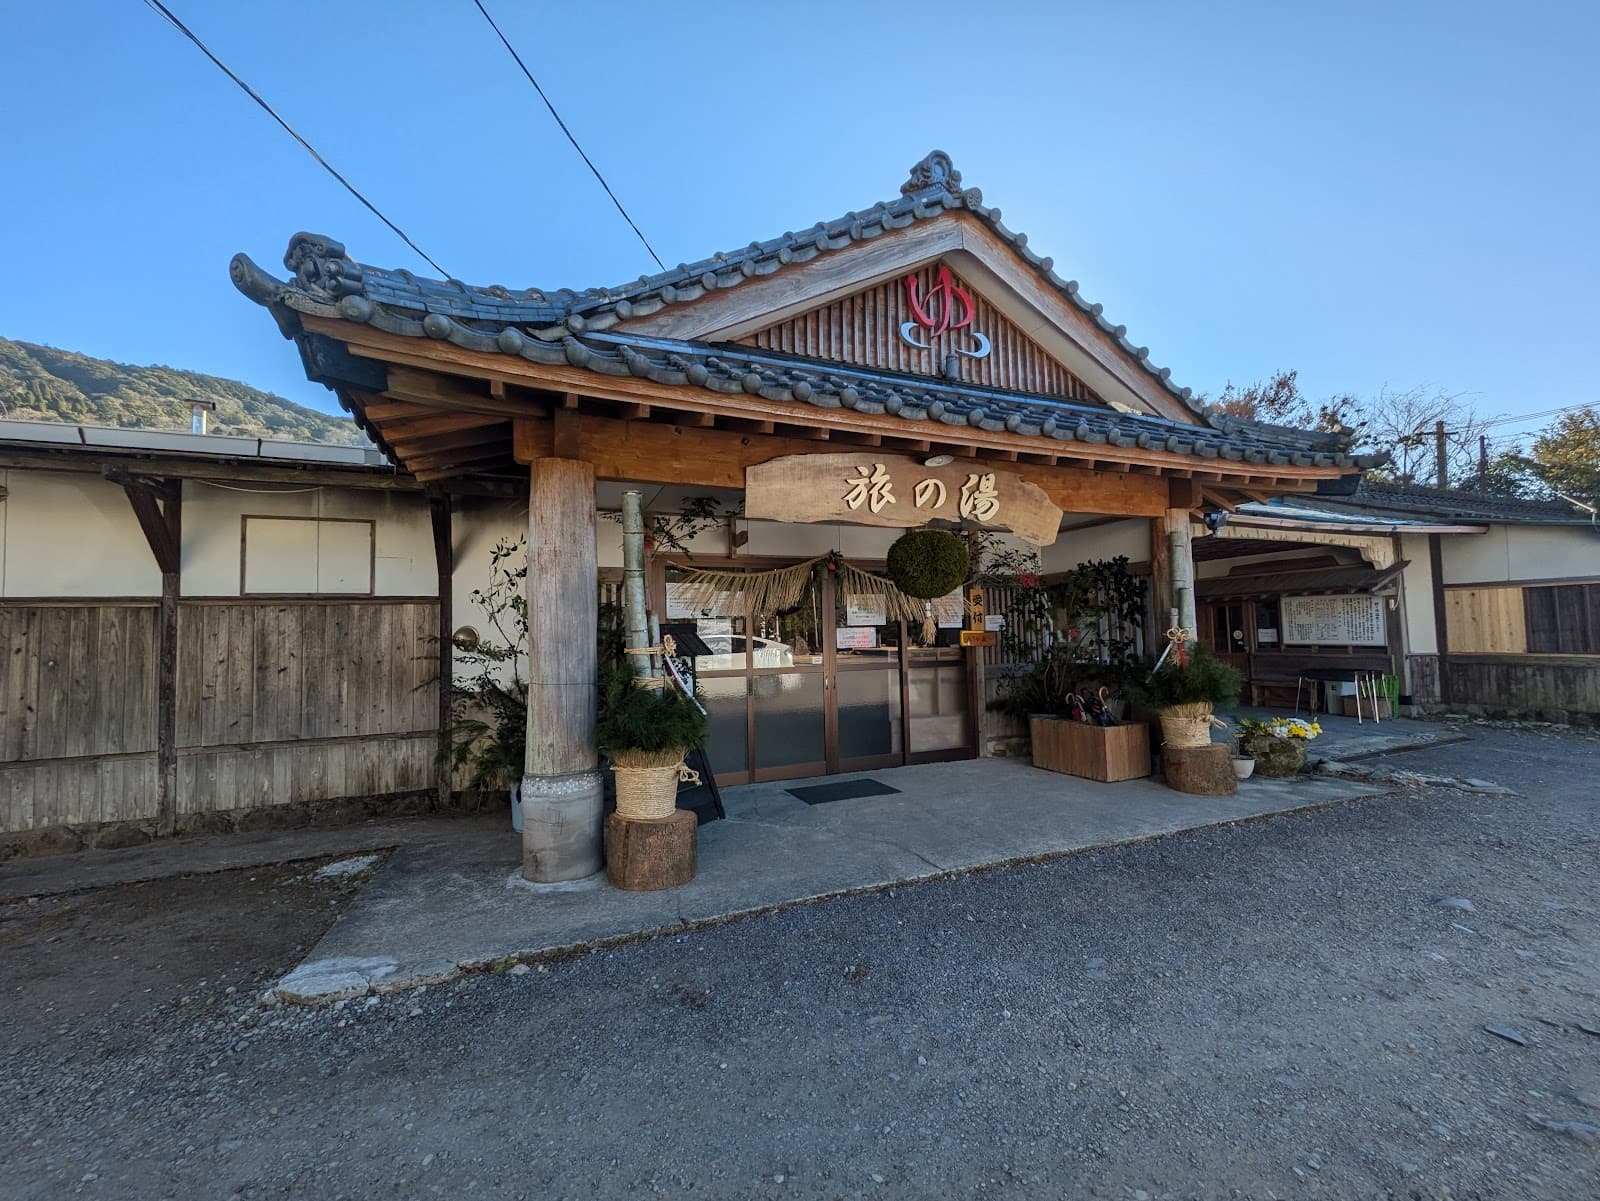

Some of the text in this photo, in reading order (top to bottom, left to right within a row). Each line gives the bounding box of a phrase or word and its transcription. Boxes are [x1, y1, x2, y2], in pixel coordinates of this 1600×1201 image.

[904, 265, 975, 338] ゆ
[842, 464, 1000, 521] 旅の湯
[973, 594, 983, 623] 受付
